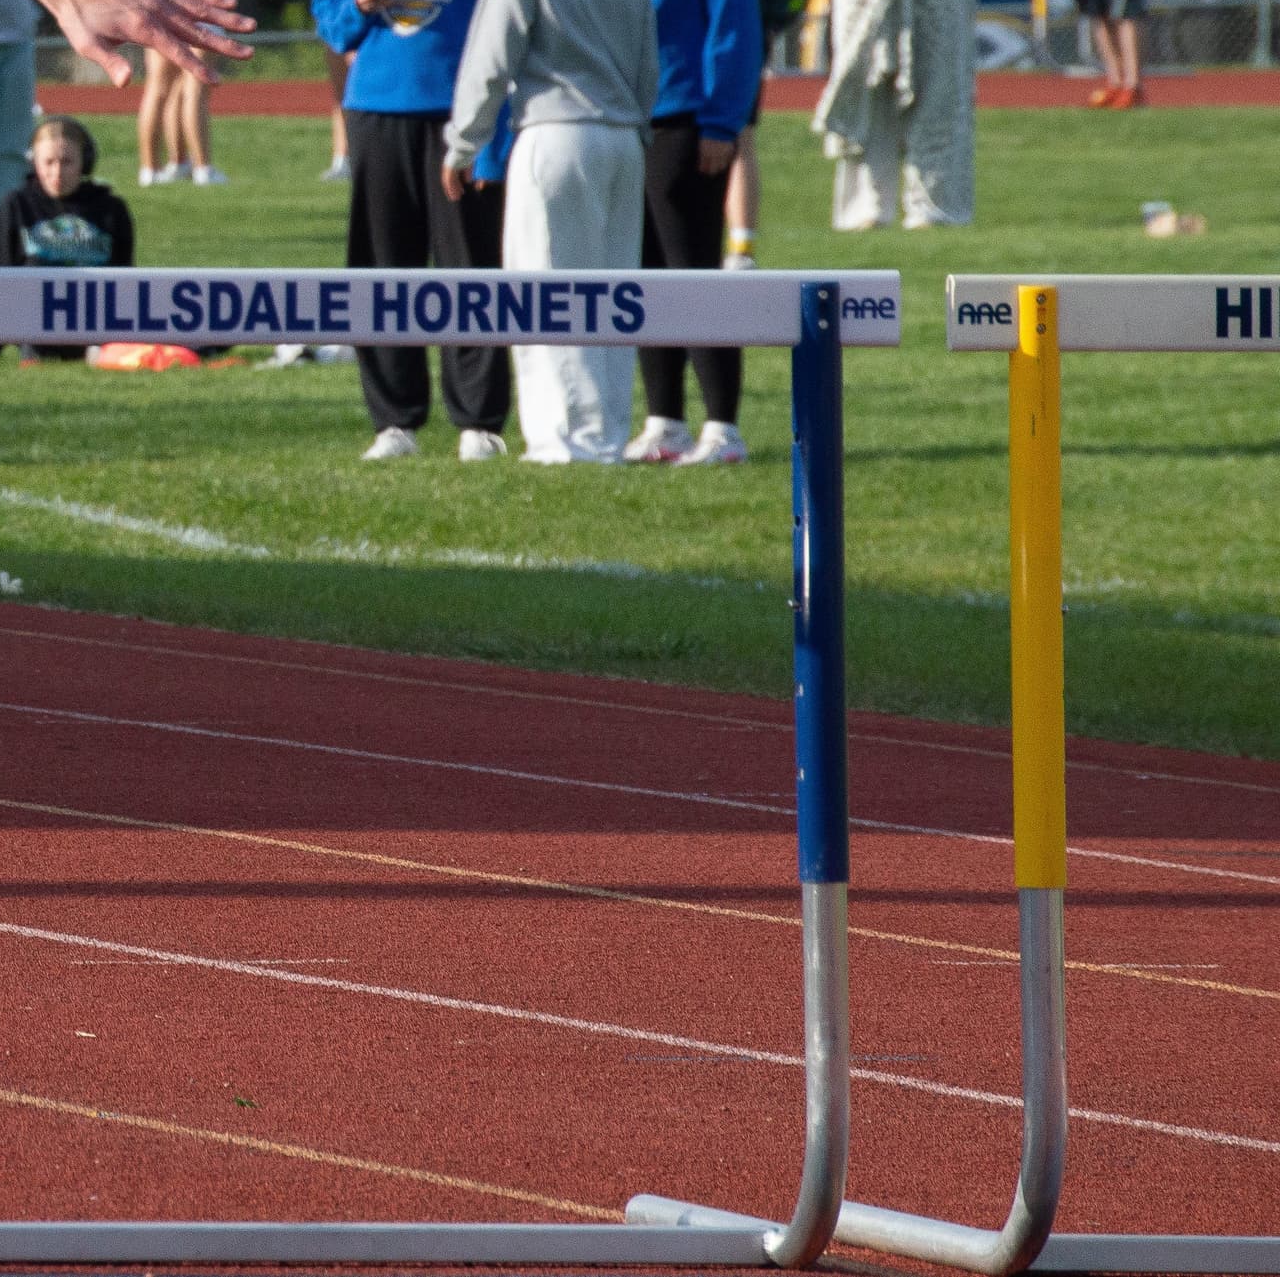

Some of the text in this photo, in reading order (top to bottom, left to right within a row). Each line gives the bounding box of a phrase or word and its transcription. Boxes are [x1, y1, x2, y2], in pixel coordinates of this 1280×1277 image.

[42, 280, 646, 334] HILLSDALE HORNETS
[1215, 287, 1280, 339] HI
